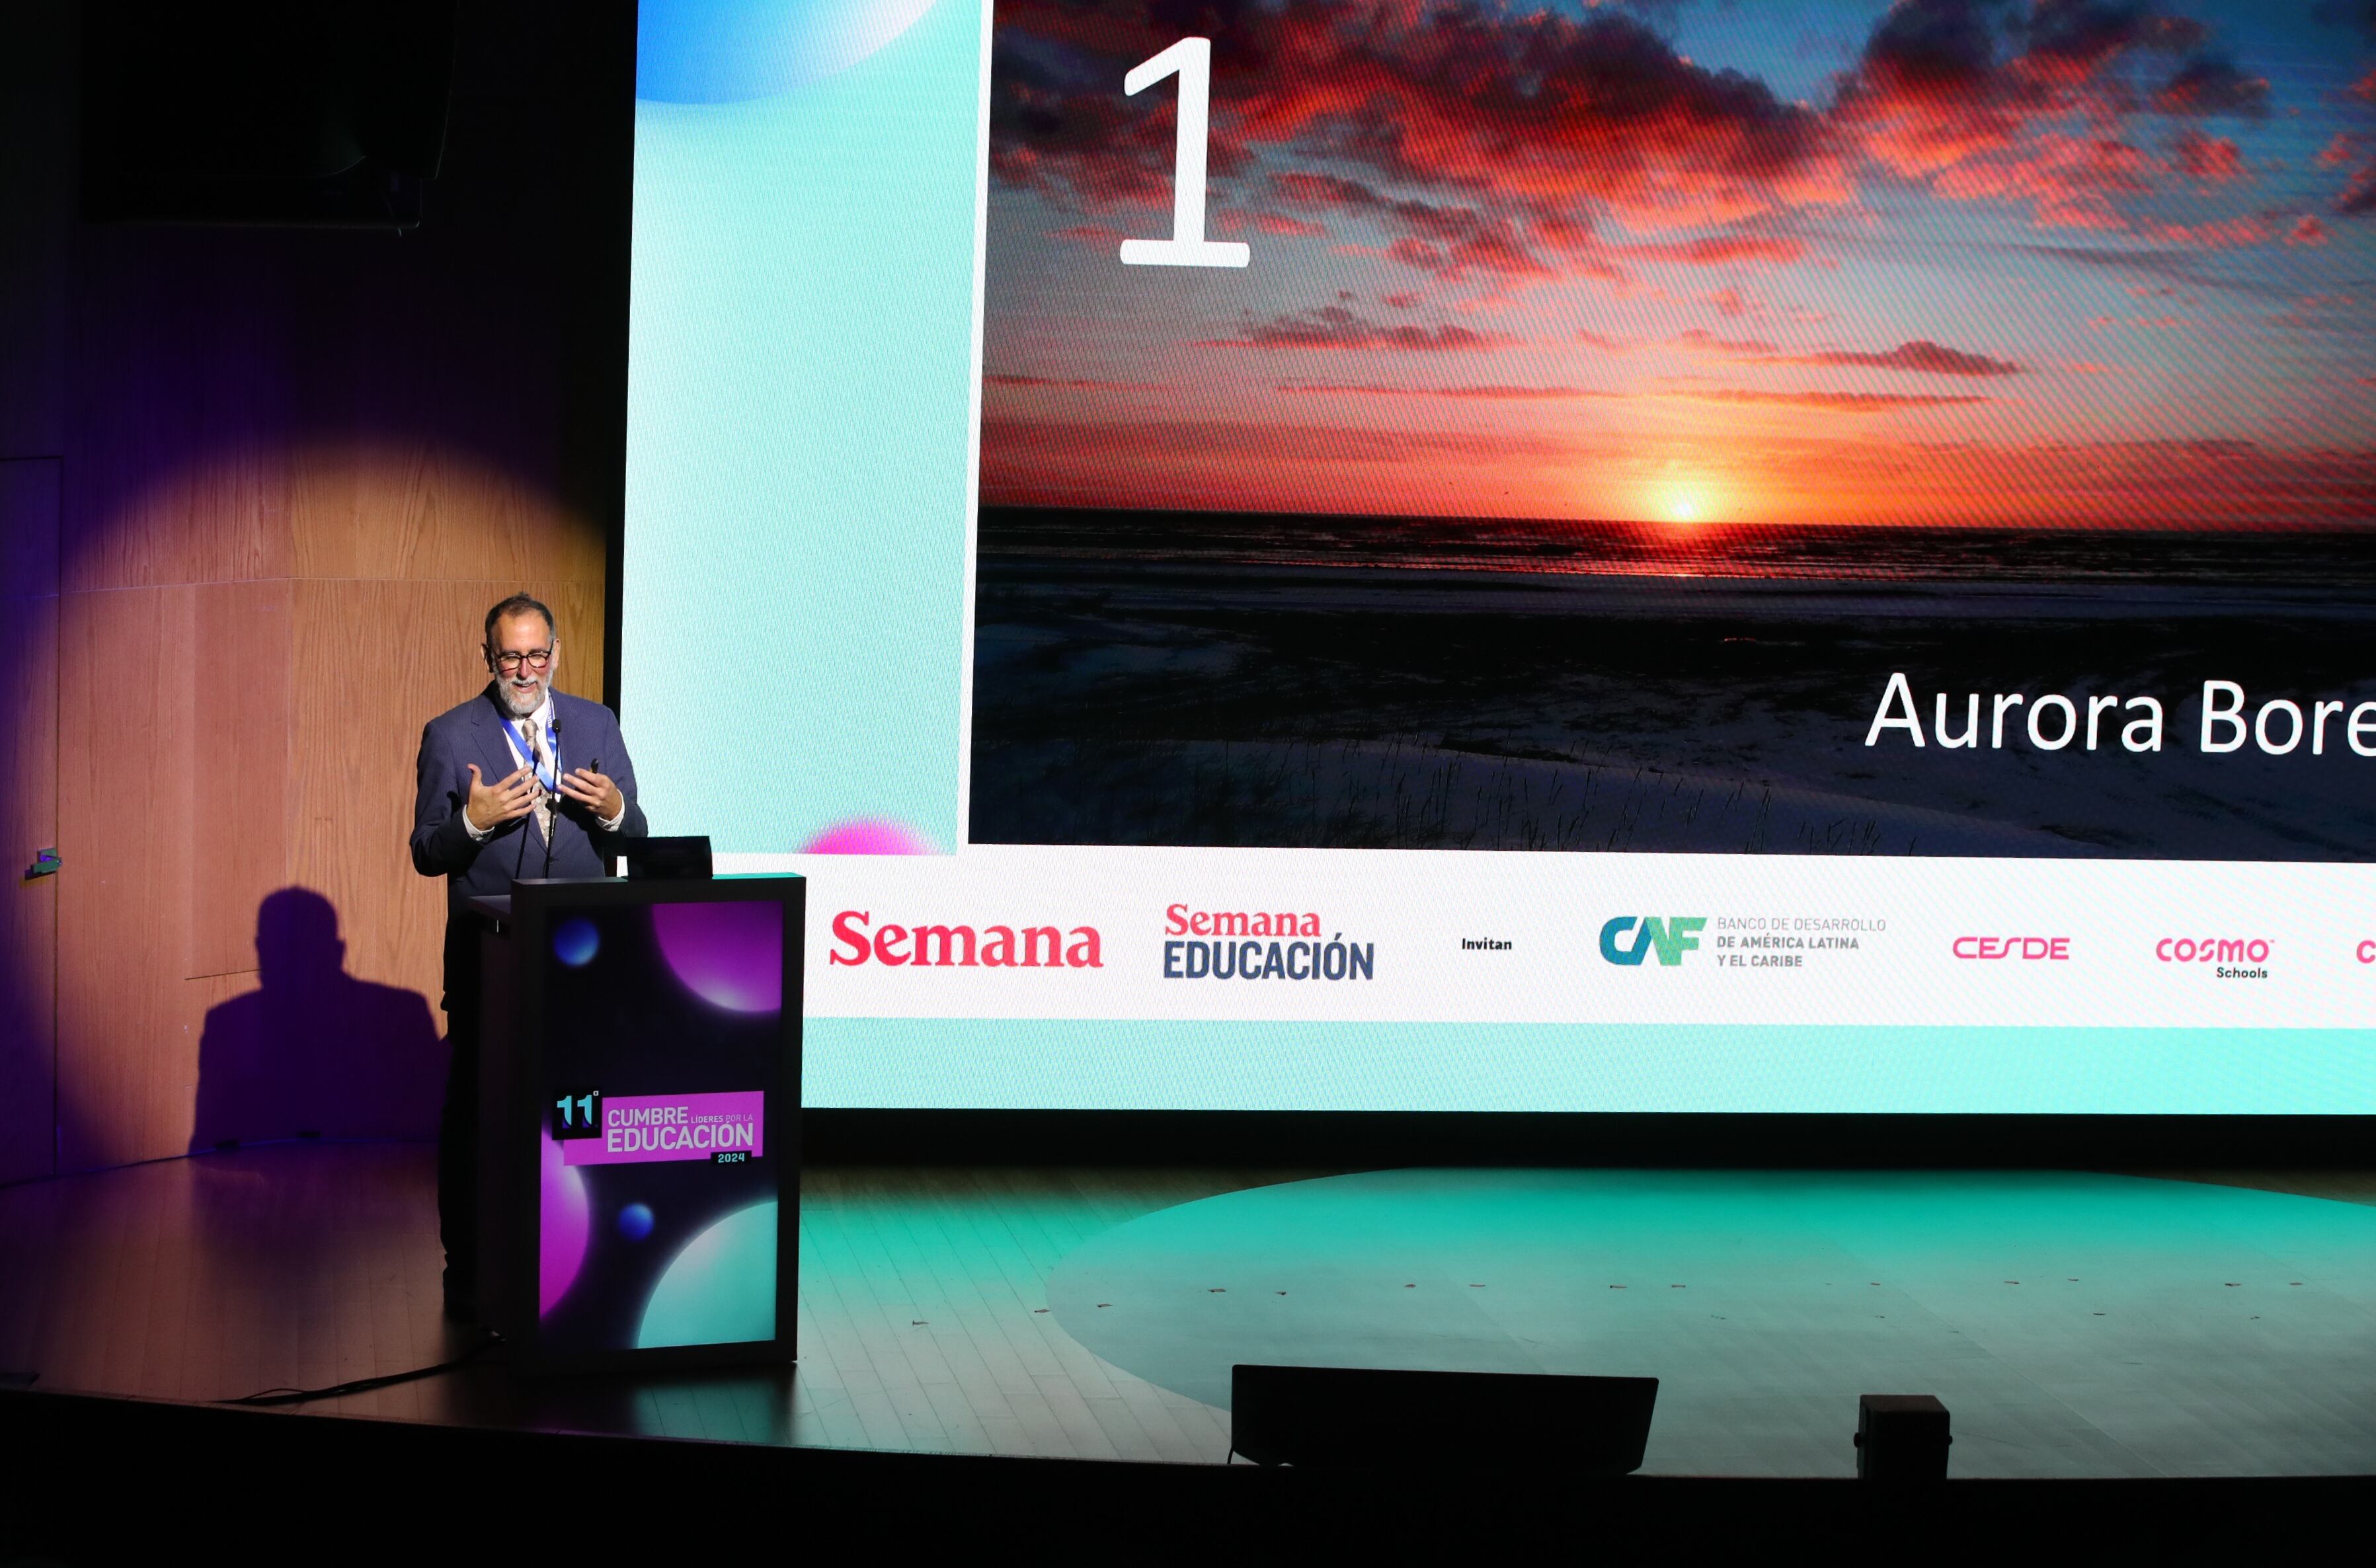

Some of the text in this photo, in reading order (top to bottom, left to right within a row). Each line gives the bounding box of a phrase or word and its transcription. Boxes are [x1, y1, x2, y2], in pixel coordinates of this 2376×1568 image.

[1120, 36, 1250, 268] 1
[1864, 672, 2164, 752] Aurora
[1164, 903, 1322, 937] Semana
[1718, 917, 1886, 931] BANCO DE DESARROLLO
[829, 910, 1104, 968] Semana
[1462, 937, 1512, 950] Invitan
[1599, 916, 1708, 966] CAF
[1717, 933, 1859, 950] DE AMÉRICA LATINA
[1952, 937, 2071, 960] CESDE
[2156, 938, 2270, 963] COSMO
[1163, 933, 1374, 981] EDUCACIÓN
[1717, 954, 1803, 967] Y EL CARIBE
[2216, 967, 2268, 979] Schools
[608, 1106, 689, 1127] CUMBRE
[607, 1121, 754, 1153] EDUCACIÓN
[718, 1153, 745, 1163] 2024
